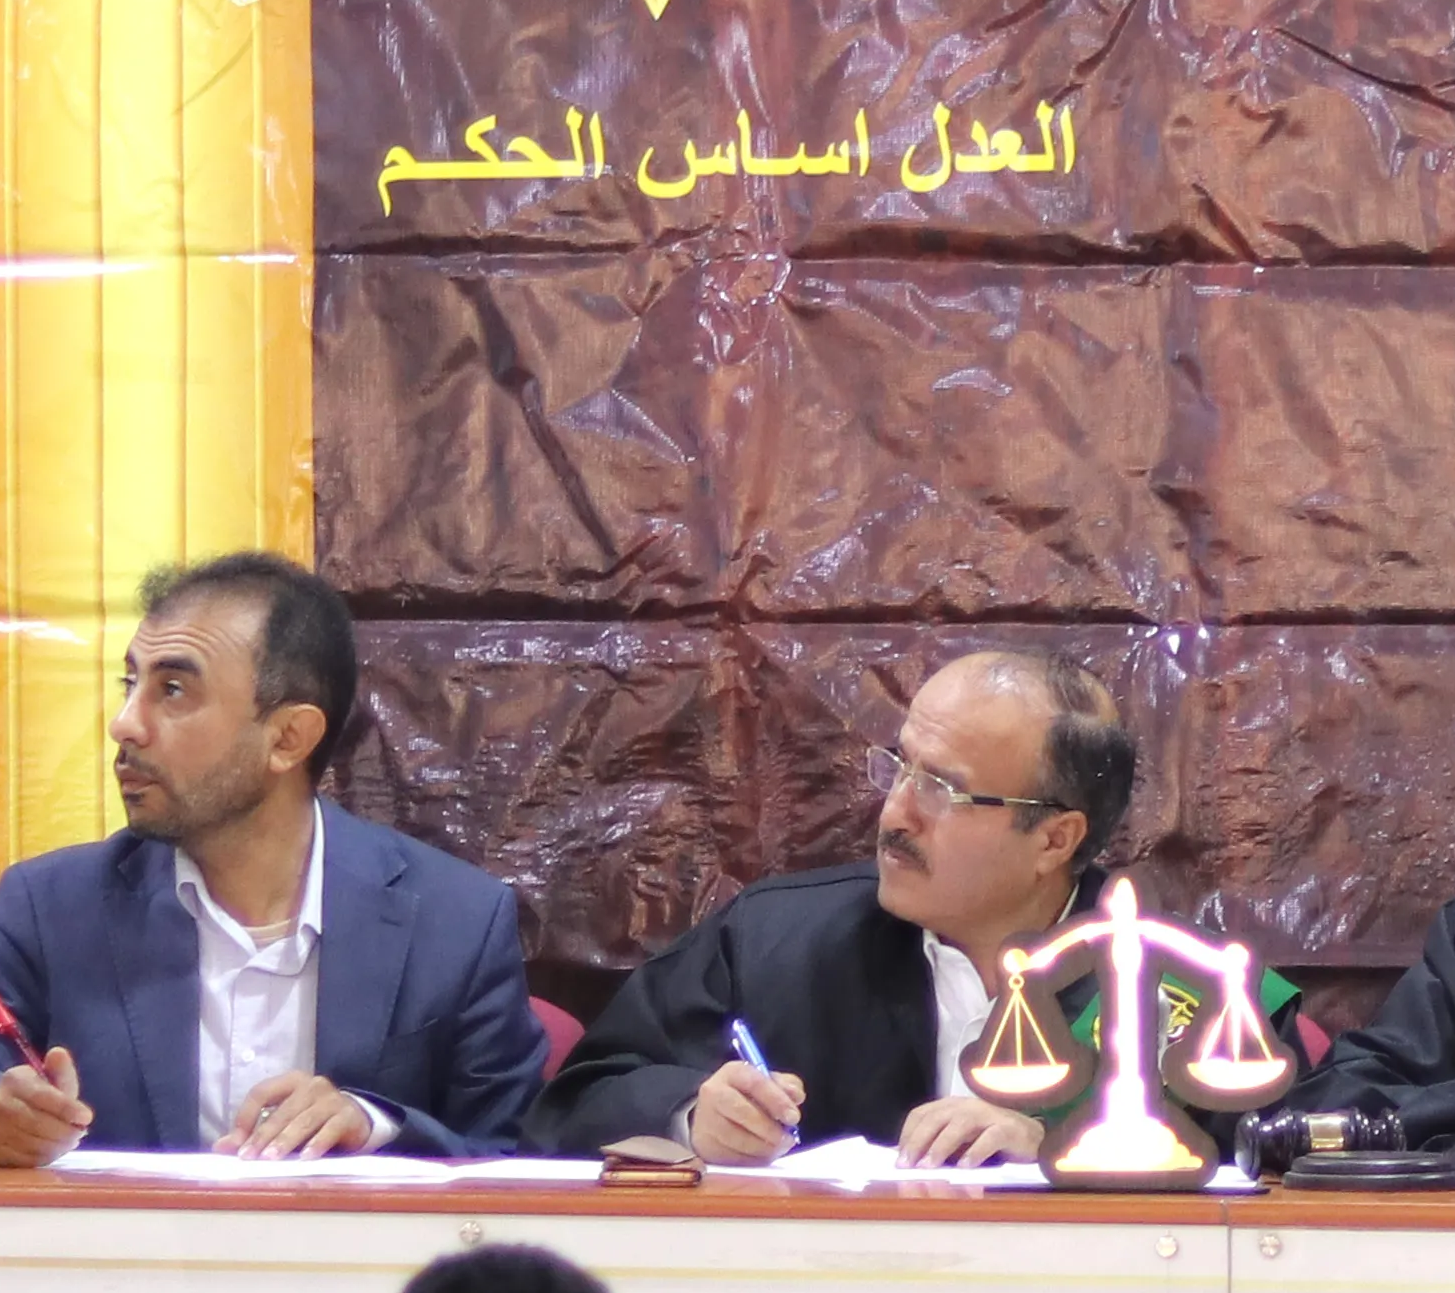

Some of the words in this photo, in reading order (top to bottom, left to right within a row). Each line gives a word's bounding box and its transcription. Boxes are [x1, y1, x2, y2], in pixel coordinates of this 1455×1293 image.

[377, 105, 605, 217] الحكم
[636, 108, 871, 199] اساس
[900, 100, 1078, 194] العدل
